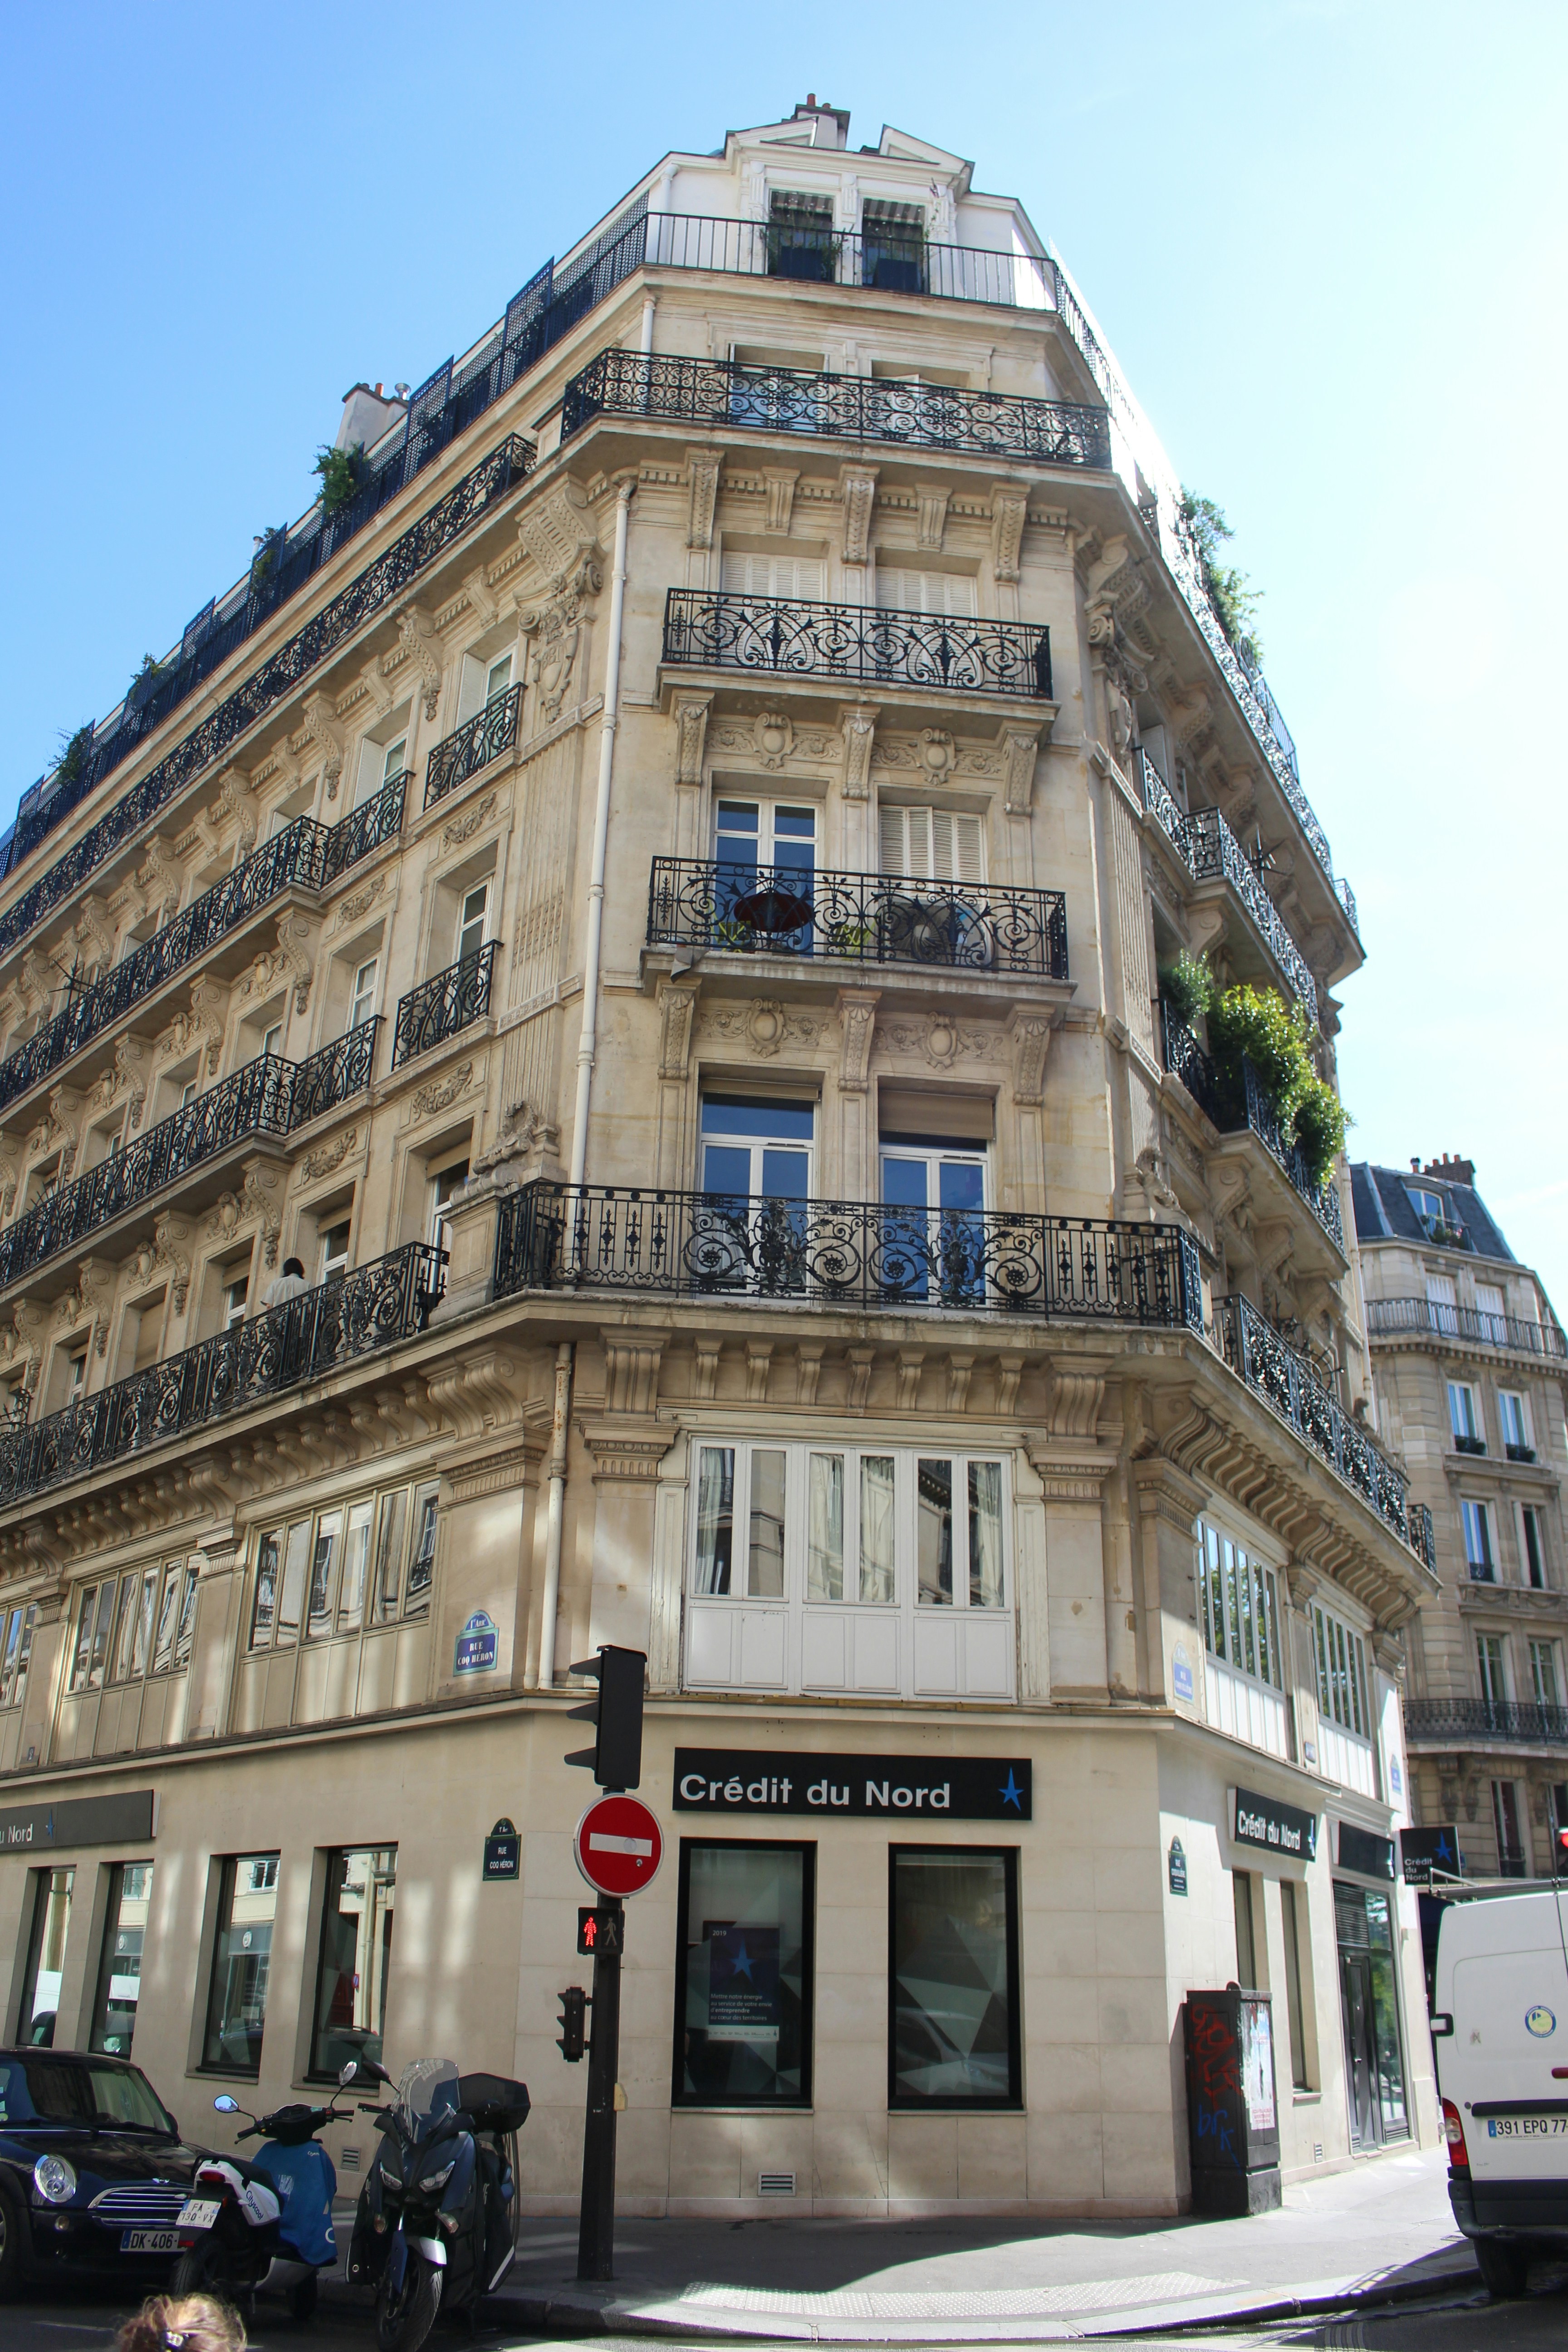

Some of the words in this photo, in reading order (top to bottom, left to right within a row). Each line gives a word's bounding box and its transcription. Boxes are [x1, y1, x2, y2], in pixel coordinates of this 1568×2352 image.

[470, 1642, 483, 1651] RUE
[457, 1657, 470, 1666] COQ
[471, 1651, 494, 1663] HÉRON
[680, 1774, 793, 1804] Crédit
[807, 1779, 849, 1805] du
[866, 1781, 950, 1808] Nord
[8, 1823, 33, 1843] Nord
[1238, 1810, 1266, 1840] Crédit
[1268, 1820, 1279, 1844] du
[1281, 1823, 1301, 1850] Nord
[490, 1861, 499, 1869] COQ
[500, 1859, 514, 1868] HÉRON
[1404, 1857, 1433, 1866] Crédit
[1496, 2121, 1519, 2135] 391
[1523, 2120, 1548, 2134] EPQ
[1551, 2119, 1567, 2133] 77
[245, 2190, 265, 2220] Cityscoot
